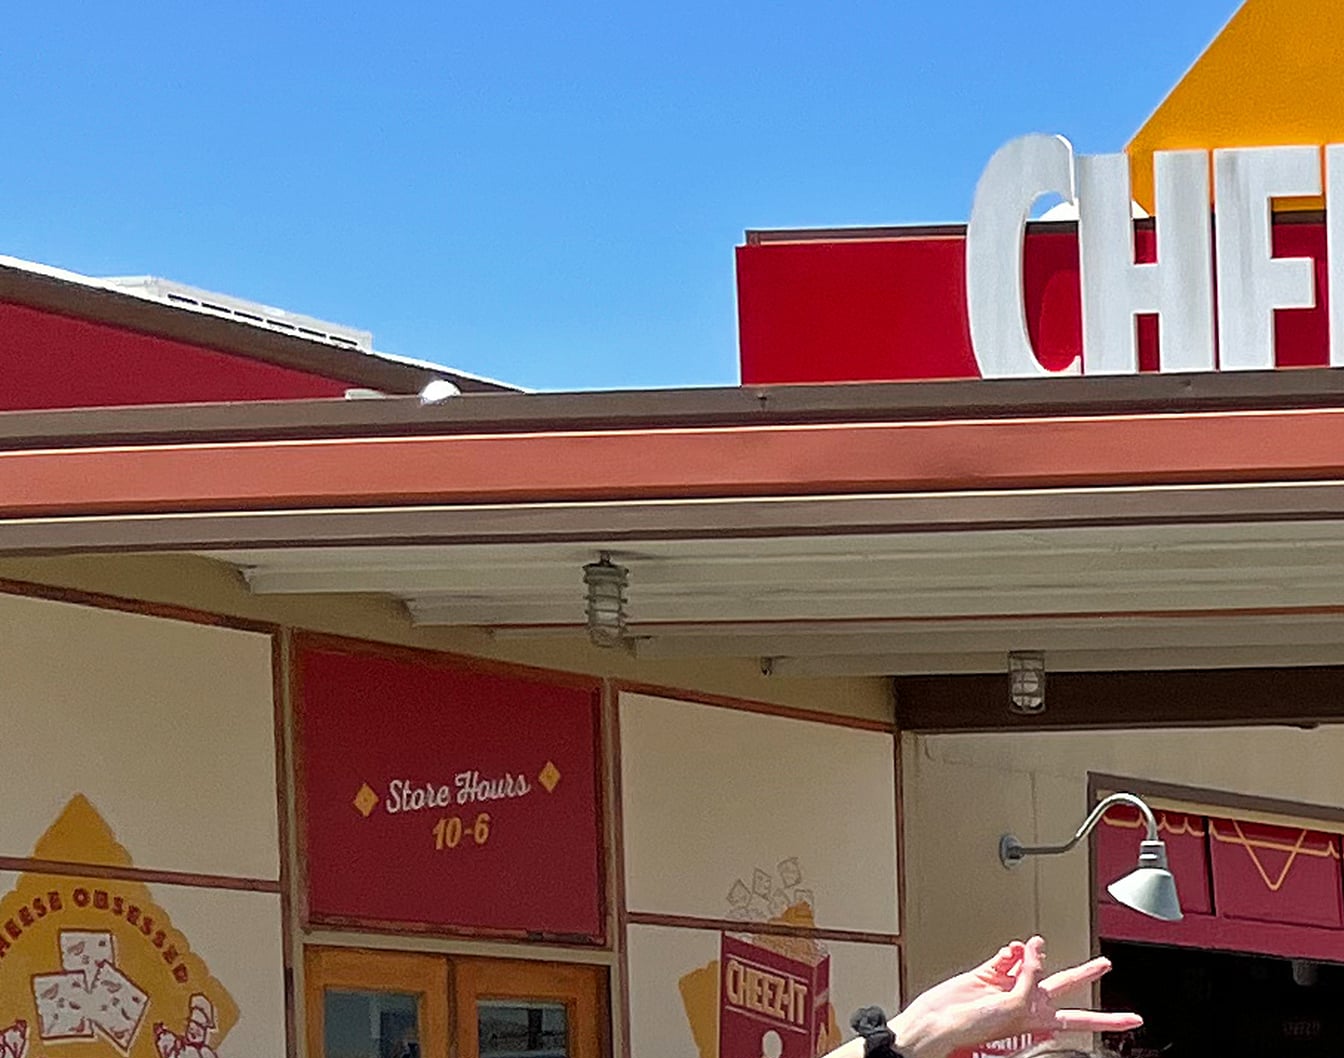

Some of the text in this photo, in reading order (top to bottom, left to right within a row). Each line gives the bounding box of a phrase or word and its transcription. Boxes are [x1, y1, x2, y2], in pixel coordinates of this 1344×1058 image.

[386, 770, 532, 814] Store Hours
[432, 812, 491, 850] 10-6
[0, 891, 63, 958] HEESE
